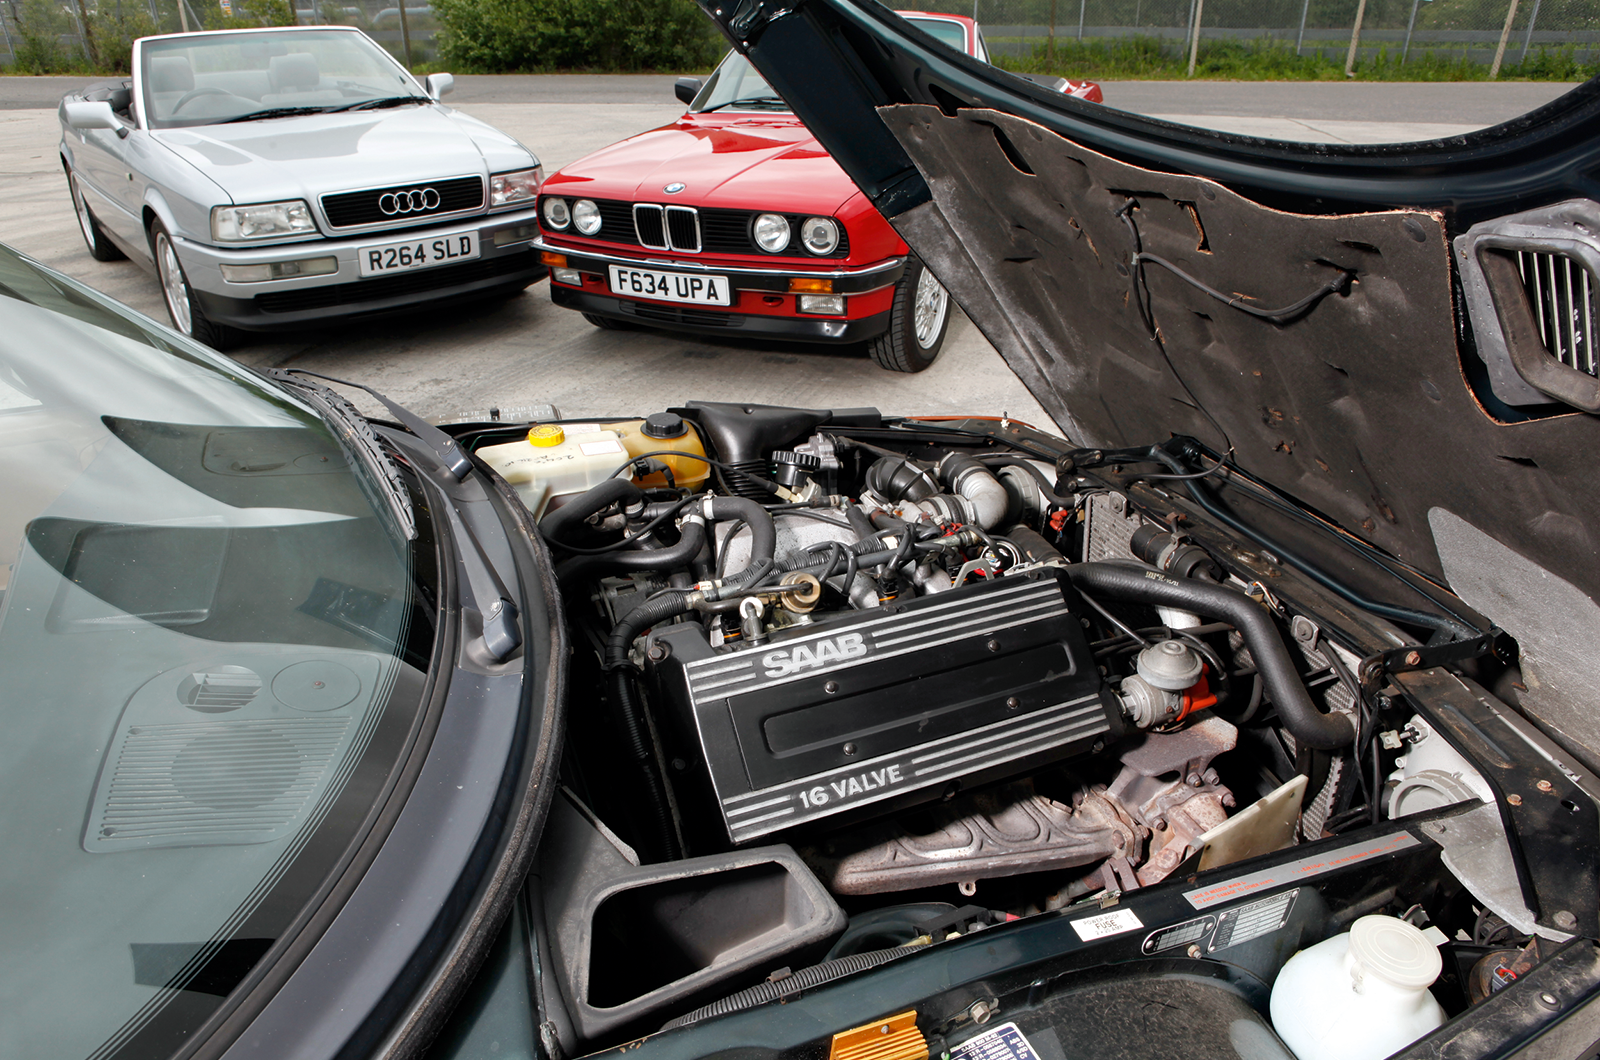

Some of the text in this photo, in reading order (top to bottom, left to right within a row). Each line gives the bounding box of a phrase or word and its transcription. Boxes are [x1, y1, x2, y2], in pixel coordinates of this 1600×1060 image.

[369, 236, 471, 271] R264 SLD
[617, 269, 719, 301] F634 UPA
[762, 632, 867, 678] SAAB
[799, 764, 904, 809] 16 VALVE
[1209, 886, 1228, 895] NEEDED
[1216, 889, 1237, 898] DAMAGE
[1095, 920, 1117, 930] FUSE
